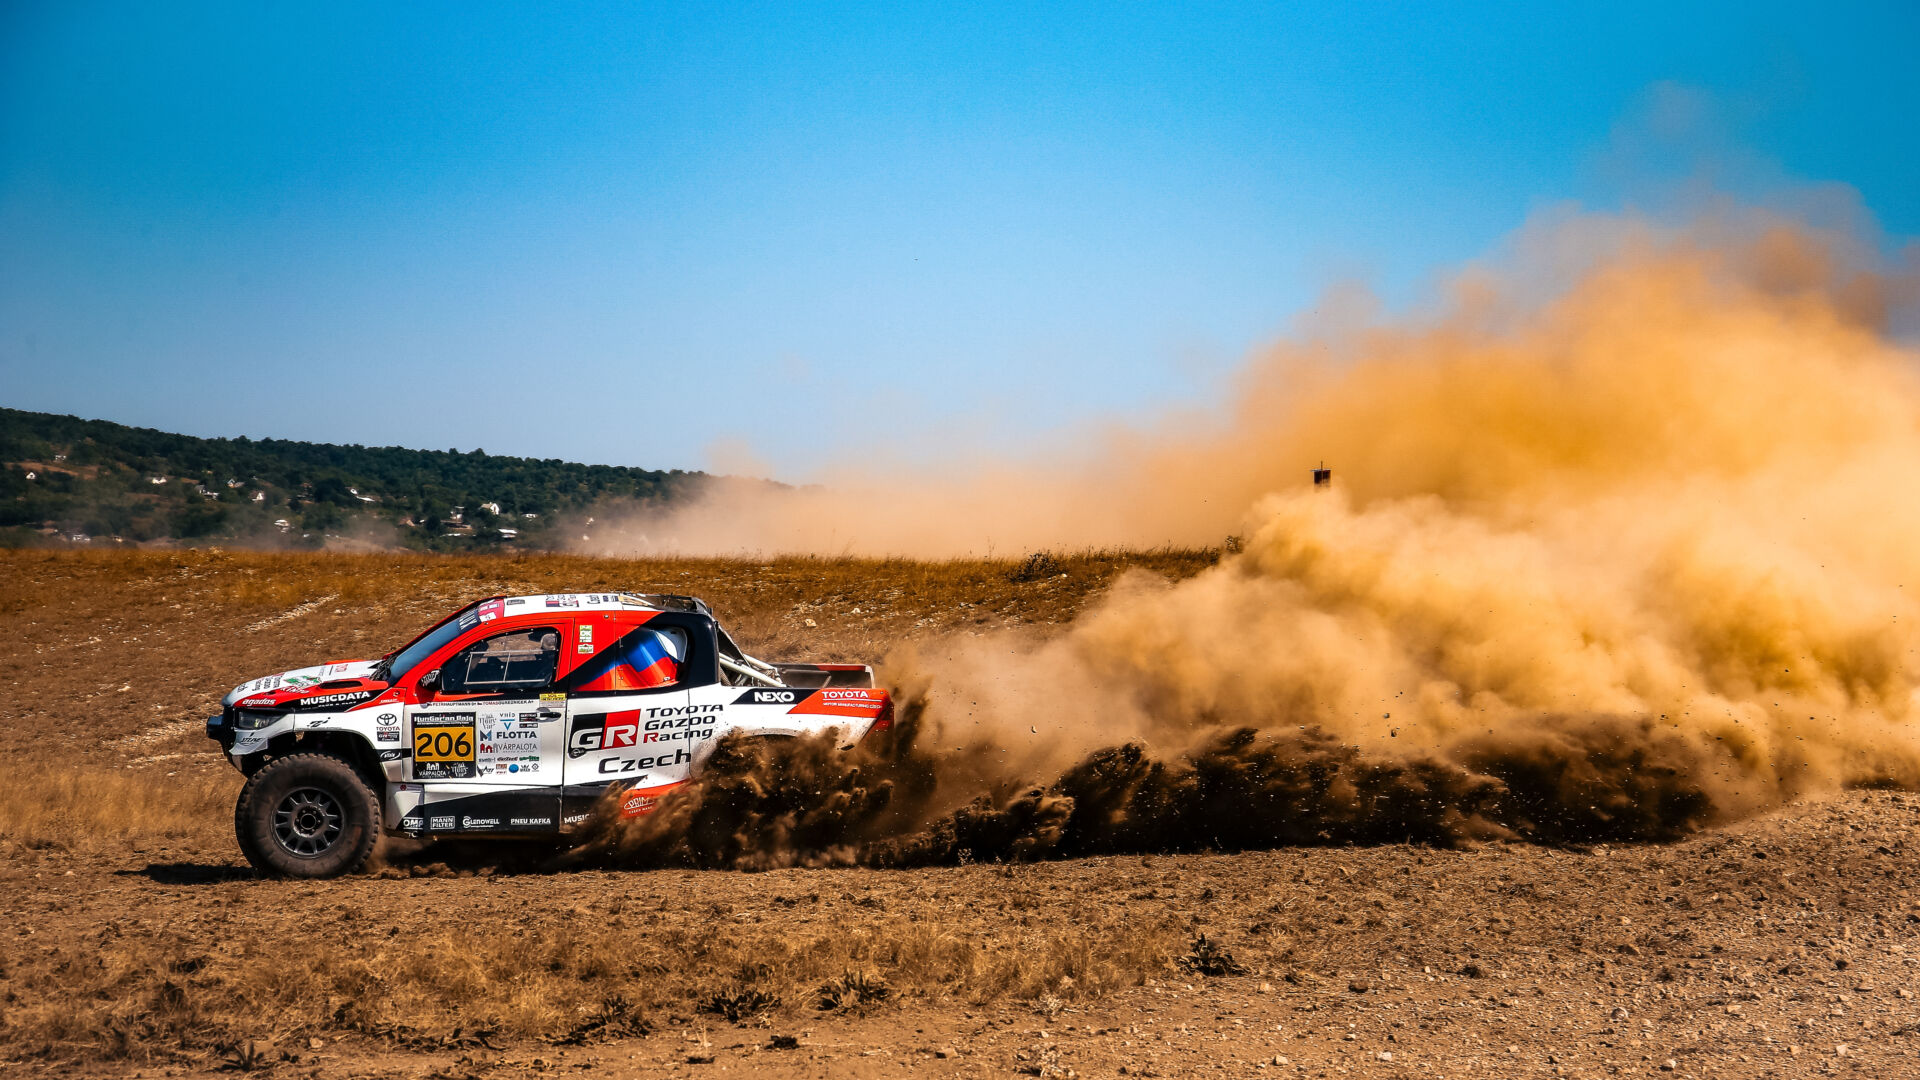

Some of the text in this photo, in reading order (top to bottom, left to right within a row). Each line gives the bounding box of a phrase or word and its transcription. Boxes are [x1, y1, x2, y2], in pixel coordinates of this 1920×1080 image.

[300, 691, 370, 706] MUSICDATA
[754, 692, 794, 702] NEXO
[822, 690, 868, 698] TOYOTA
[242, 698, 276, 706] agados
[646, 704, 724, 718] TOYOTA
[644, 716, 716, 731] GAZOO
[570, 724, 636, 749] GR
[643, 728, 713, 743] Racing
[417, 732, 471, 757] 206
[598, 749, 692, 774] Czech
[564, 814, 590, 824] MUSIC
